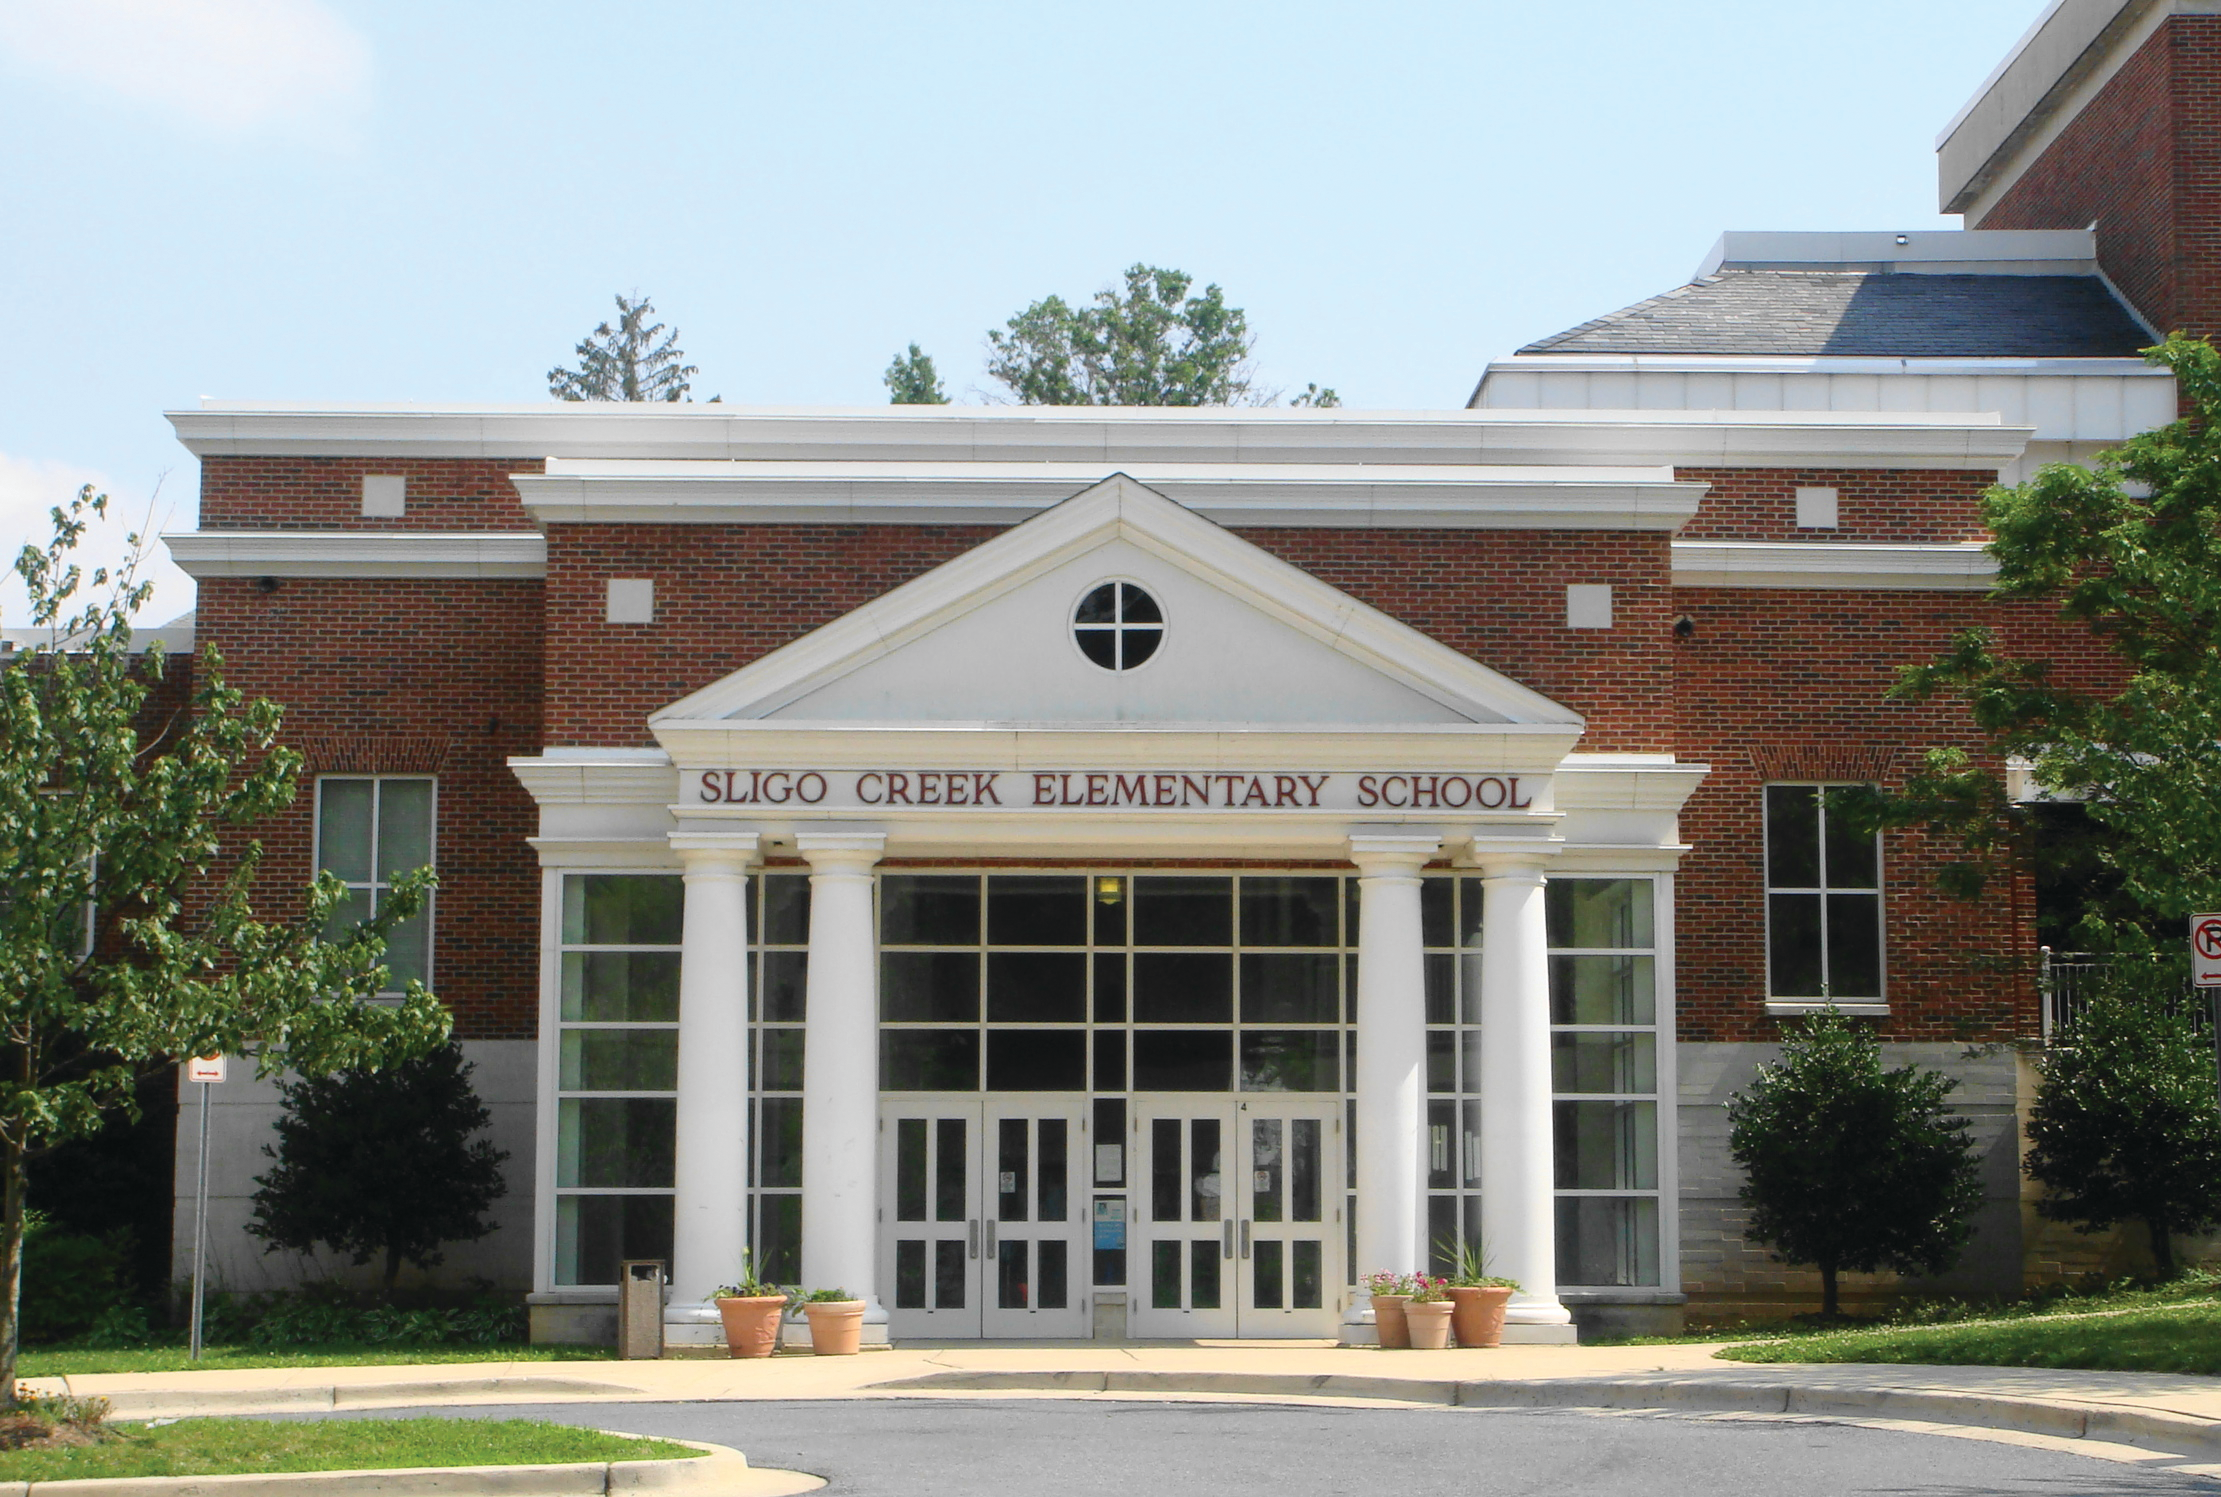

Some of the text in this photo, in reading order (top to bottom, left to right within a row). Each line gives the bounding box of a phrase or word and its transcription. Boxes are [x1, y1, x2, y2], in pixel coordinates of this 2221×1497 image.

[700, 770, 1533, 809] SLIGO CREEK ELEMENTARY SCHOOL
[1240, 1102, 1247, 1111] 4
